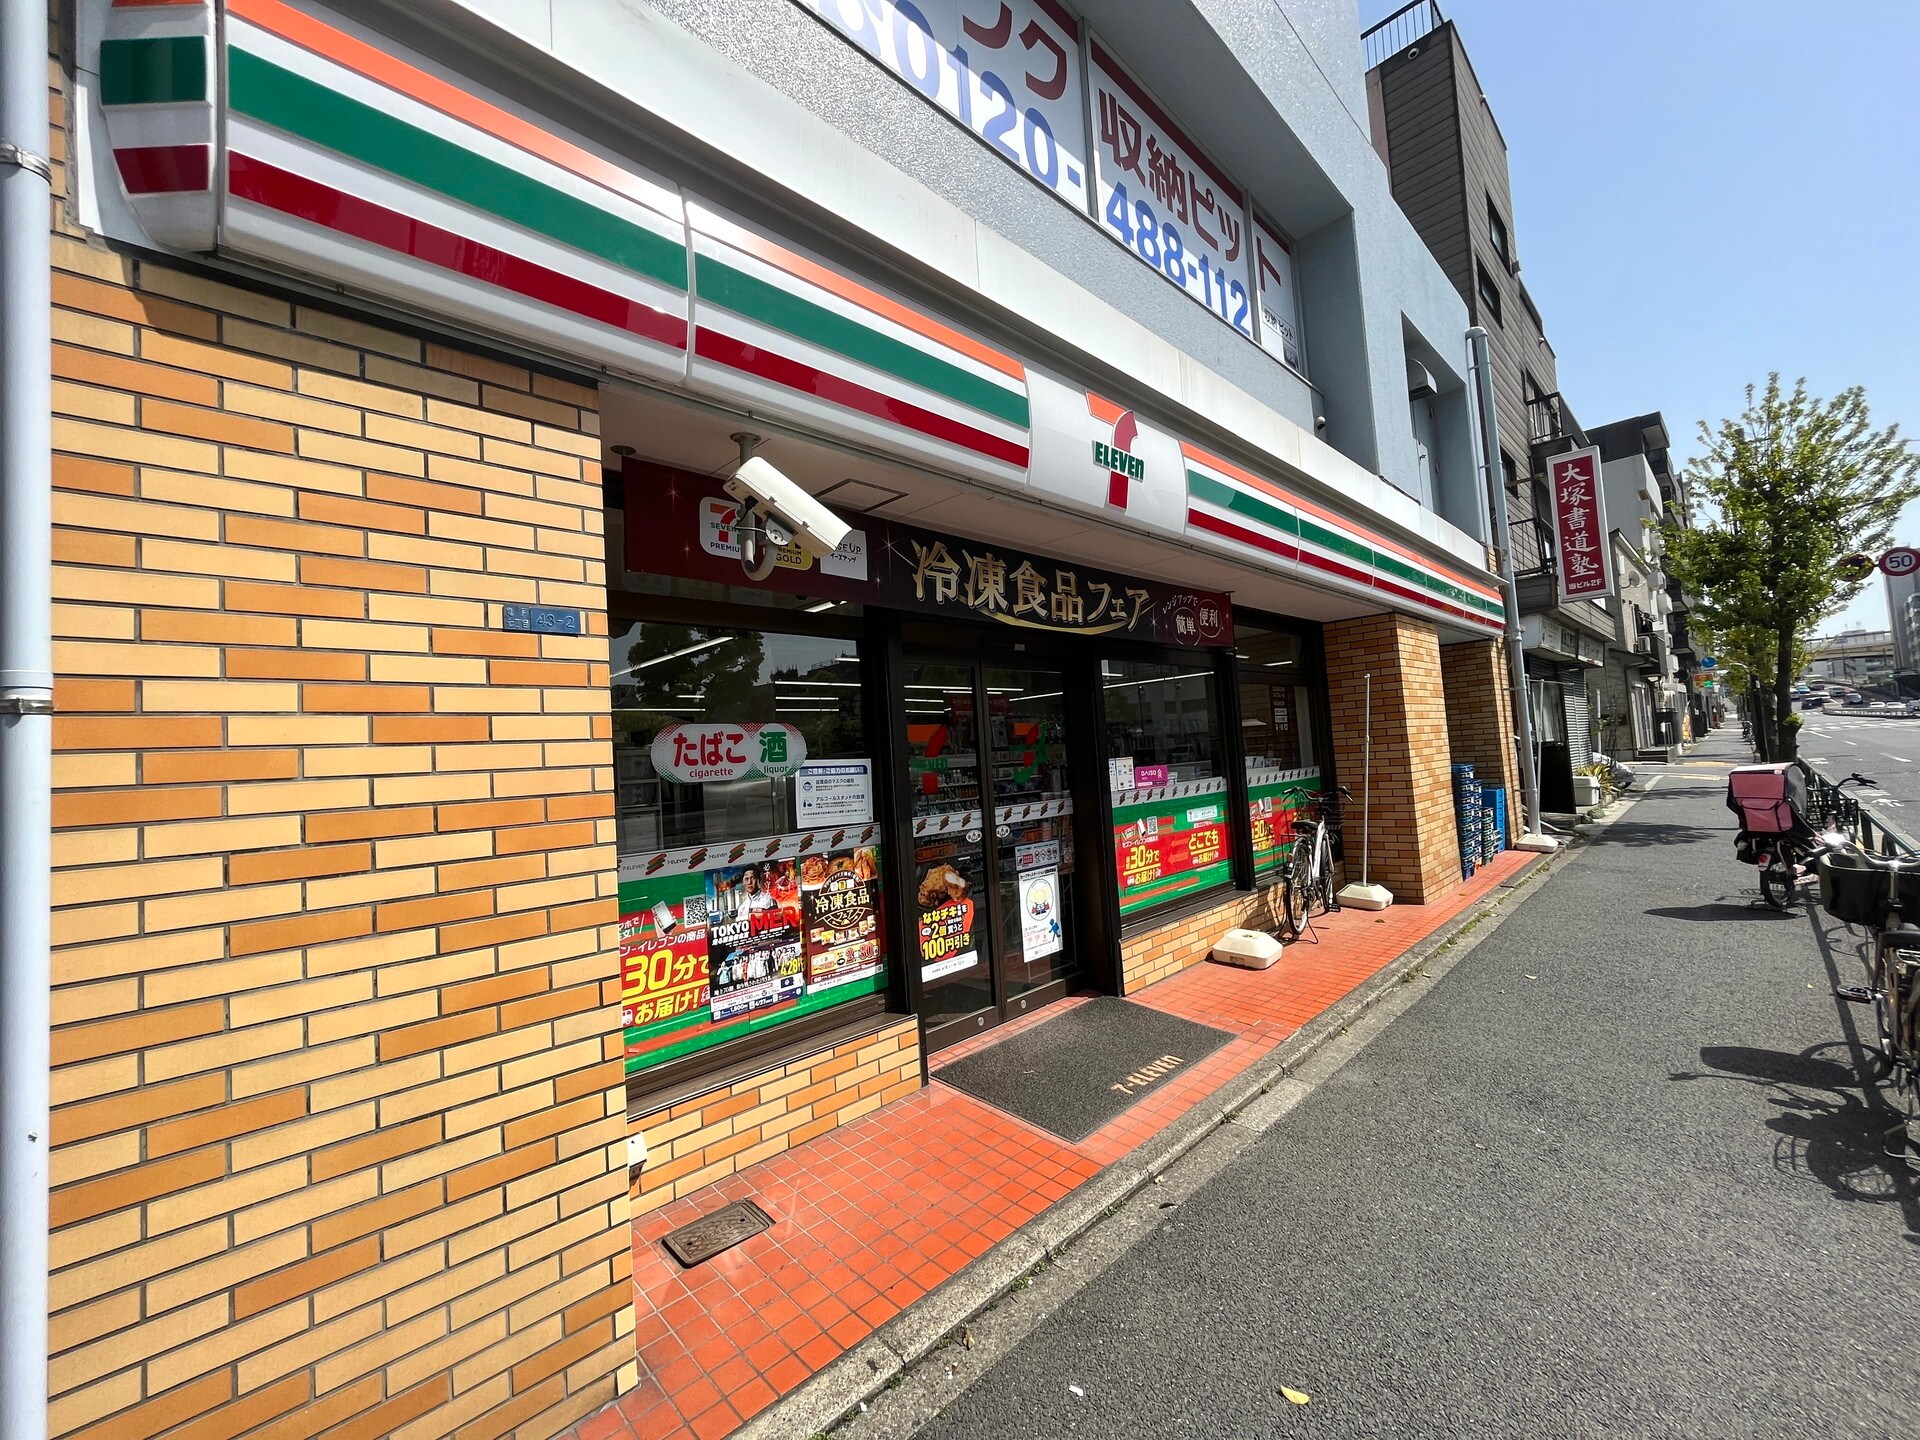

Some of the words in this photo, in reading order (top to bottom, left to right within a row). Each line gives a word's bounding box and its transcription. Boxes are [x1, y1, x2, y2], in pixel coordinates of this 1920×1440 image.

[1560, 463, 1599, 578] 大塚書道塾
[1889, 554, 1913, 569] 50
[910, 539, 1150, 632] 冷凍食品フェア
[536, 613, 575, 628] 43-2
[1175, 614, 1197, 635] 簡単
[1199, 607, 1218, 627] 便利
[673, 731, 747, 767] たばこ
[759, 731, 788, 763] 酒
[689, 767, 734, 779] cigarette
[763, 765, 789, 775] liquor
[1188, 829, 1219, 851] どこでも
[815, 888, 870, 914] 冷凍食品
[711, 920, 749, 939] TOKYO
[749, 905, 800, 936] MER
[923, 933, 971, 960] 100円引き
[635, 988, 700, 1024] お届け!
